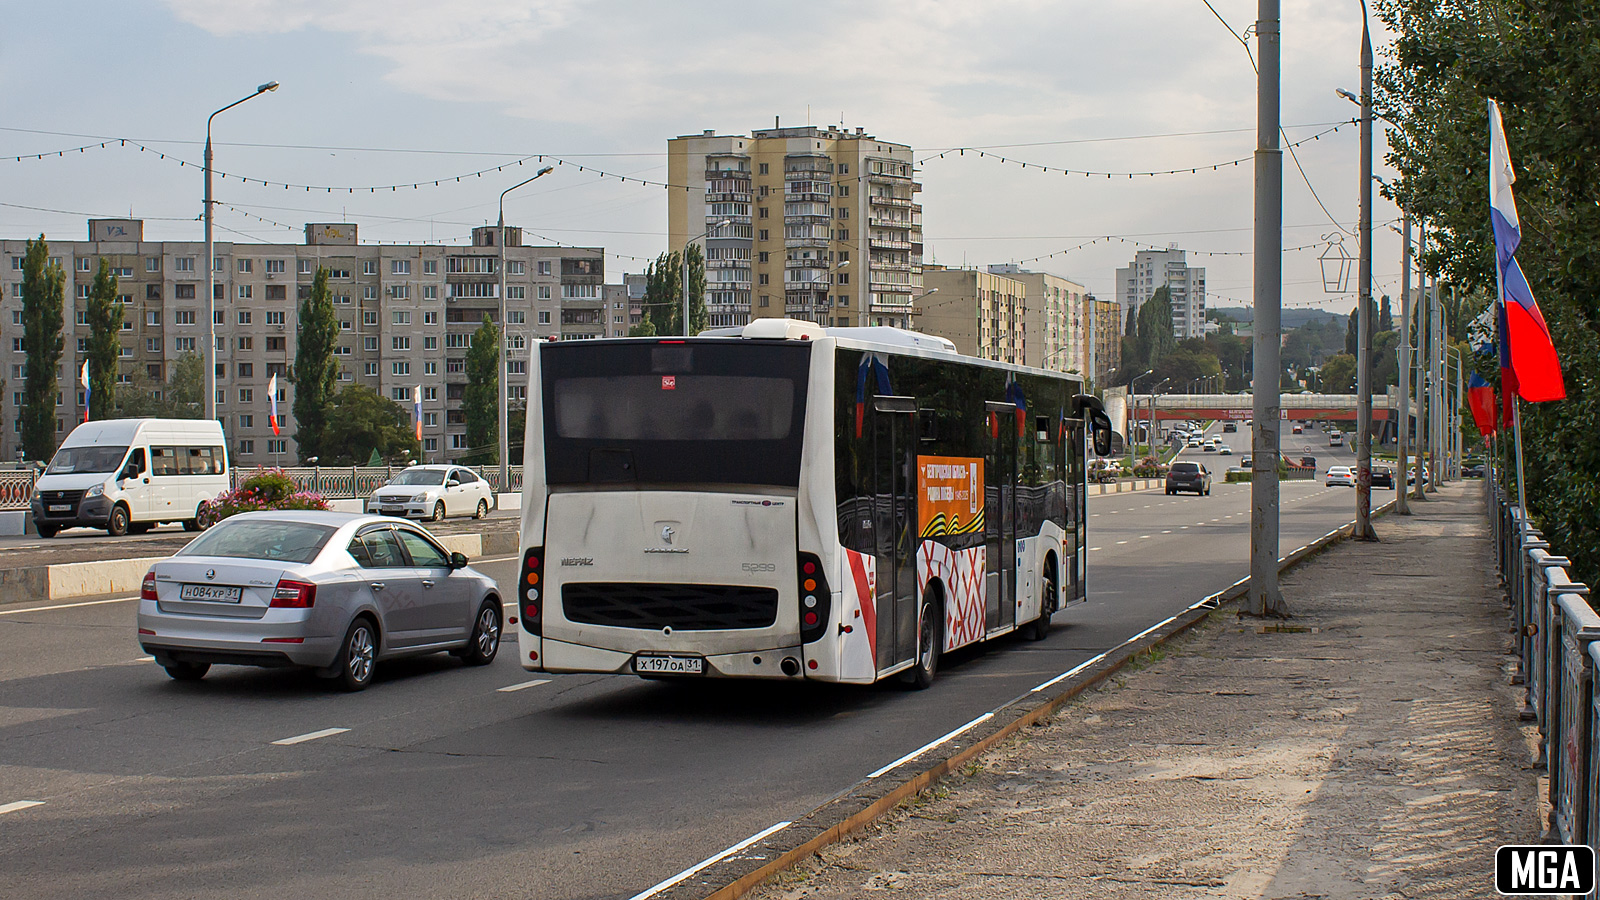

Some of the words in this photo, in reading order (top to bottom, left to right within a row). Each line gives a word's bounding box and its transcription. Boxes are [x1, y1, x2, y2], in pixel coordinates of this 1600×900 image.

[561, 558, 593, 566] NEFAZ
[741, 562, 776, 572] 5299
[227, 587, 238, 597] 31
[687, 659, 698, 669] 31
